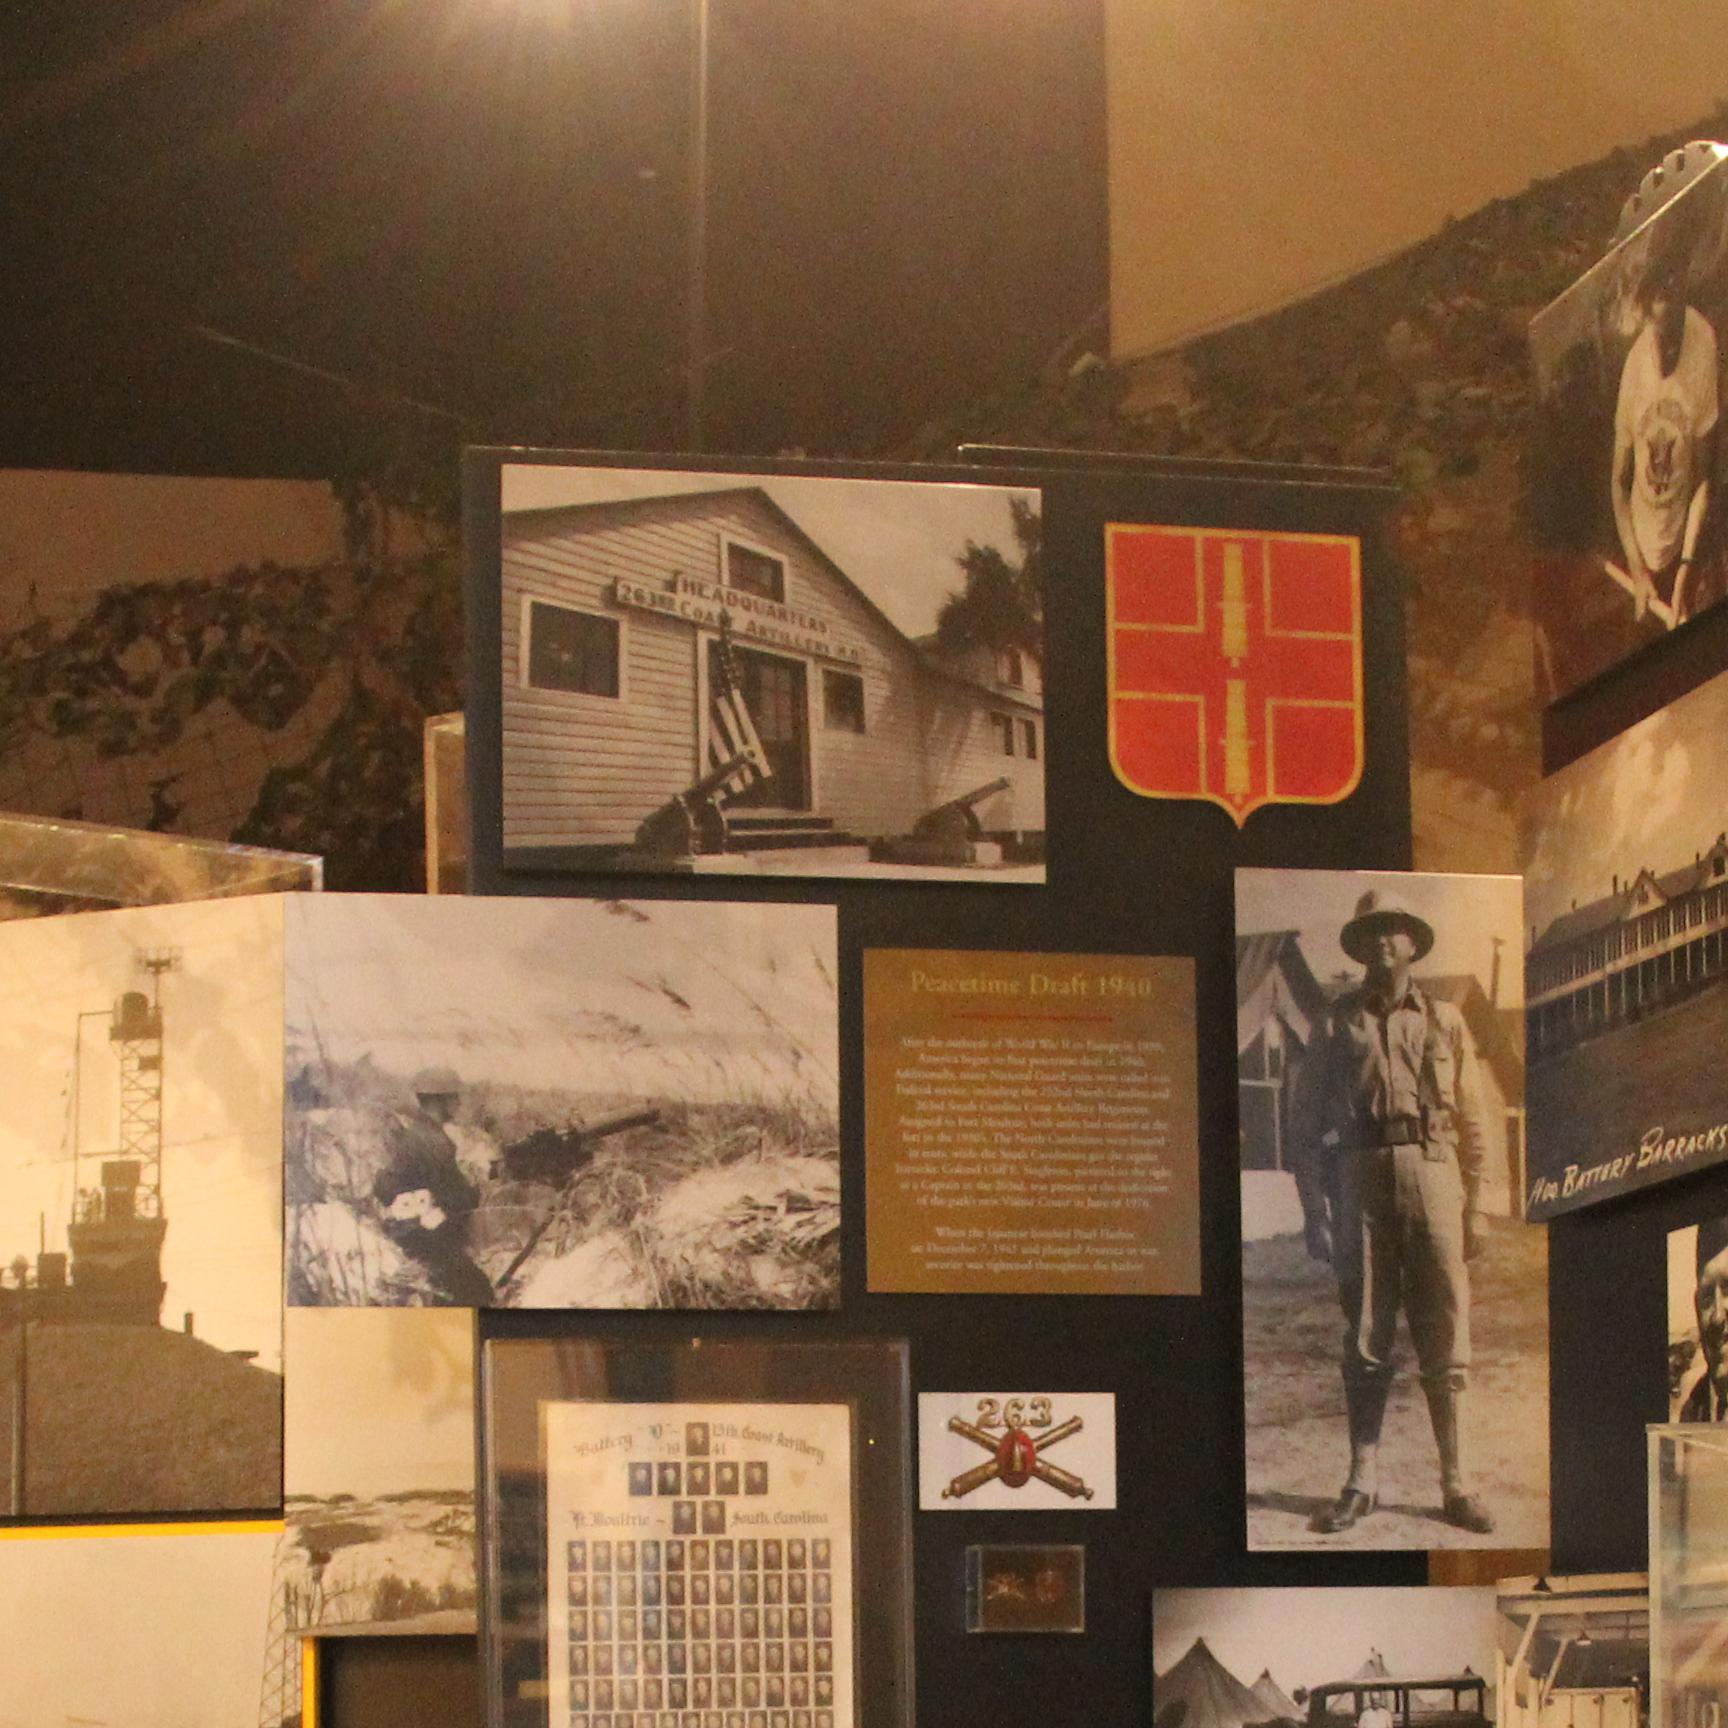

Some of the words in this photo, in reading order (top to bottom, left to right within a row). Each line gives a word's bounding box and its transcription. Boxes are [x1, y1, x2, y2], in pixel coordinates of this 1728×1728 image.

[912, 971, 1020, 995] Peacetime
[1029, 975, 1087, 996] Draft
[1099, 977, 1153, 998] 1940
[1636, 1126, 1728, 1169] BARRACKS
[976, 1396, 1053, 1428] 263
